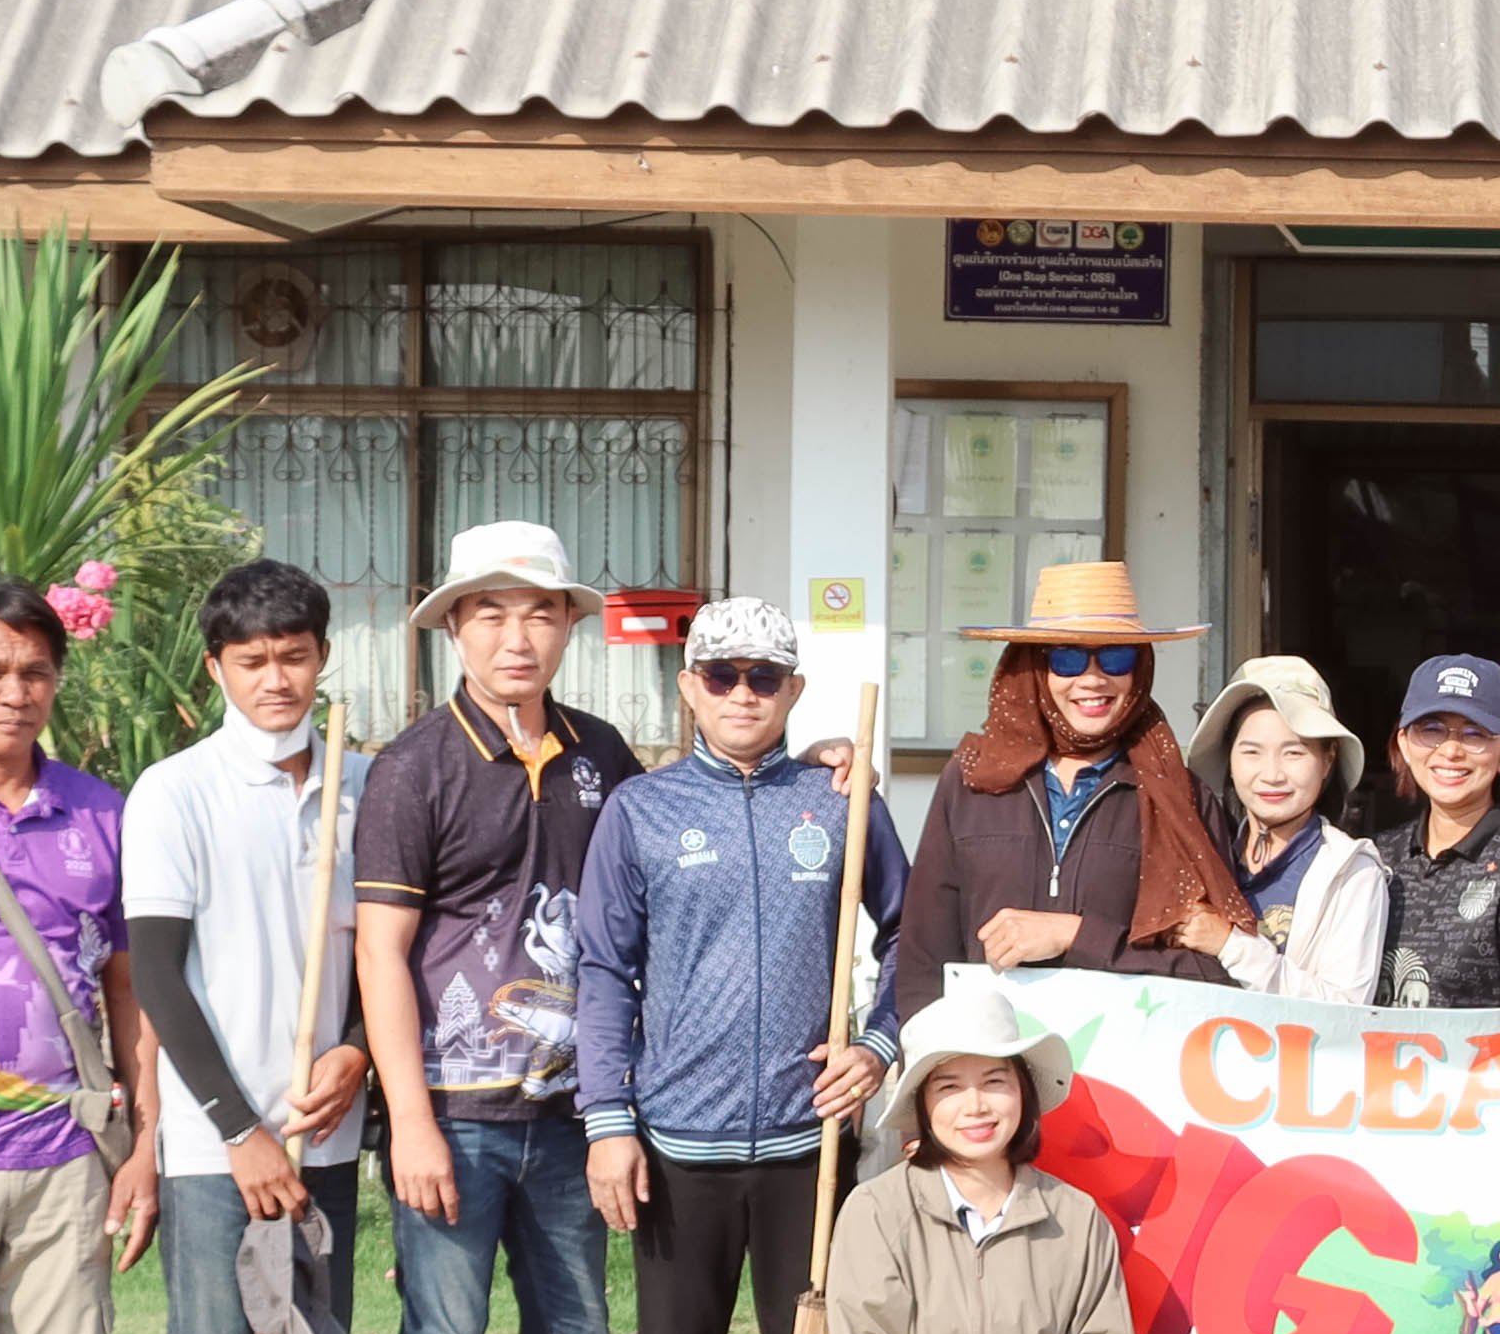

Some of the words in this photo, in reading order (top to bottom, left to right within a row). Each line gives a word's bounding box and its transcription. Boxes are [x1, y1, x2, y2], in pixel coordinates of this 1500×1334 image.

[1023, 270, 1047, 284] Stop
[1048, 270, 1084, 283] Service
[677, 850, 719, 869] YAMAHA
